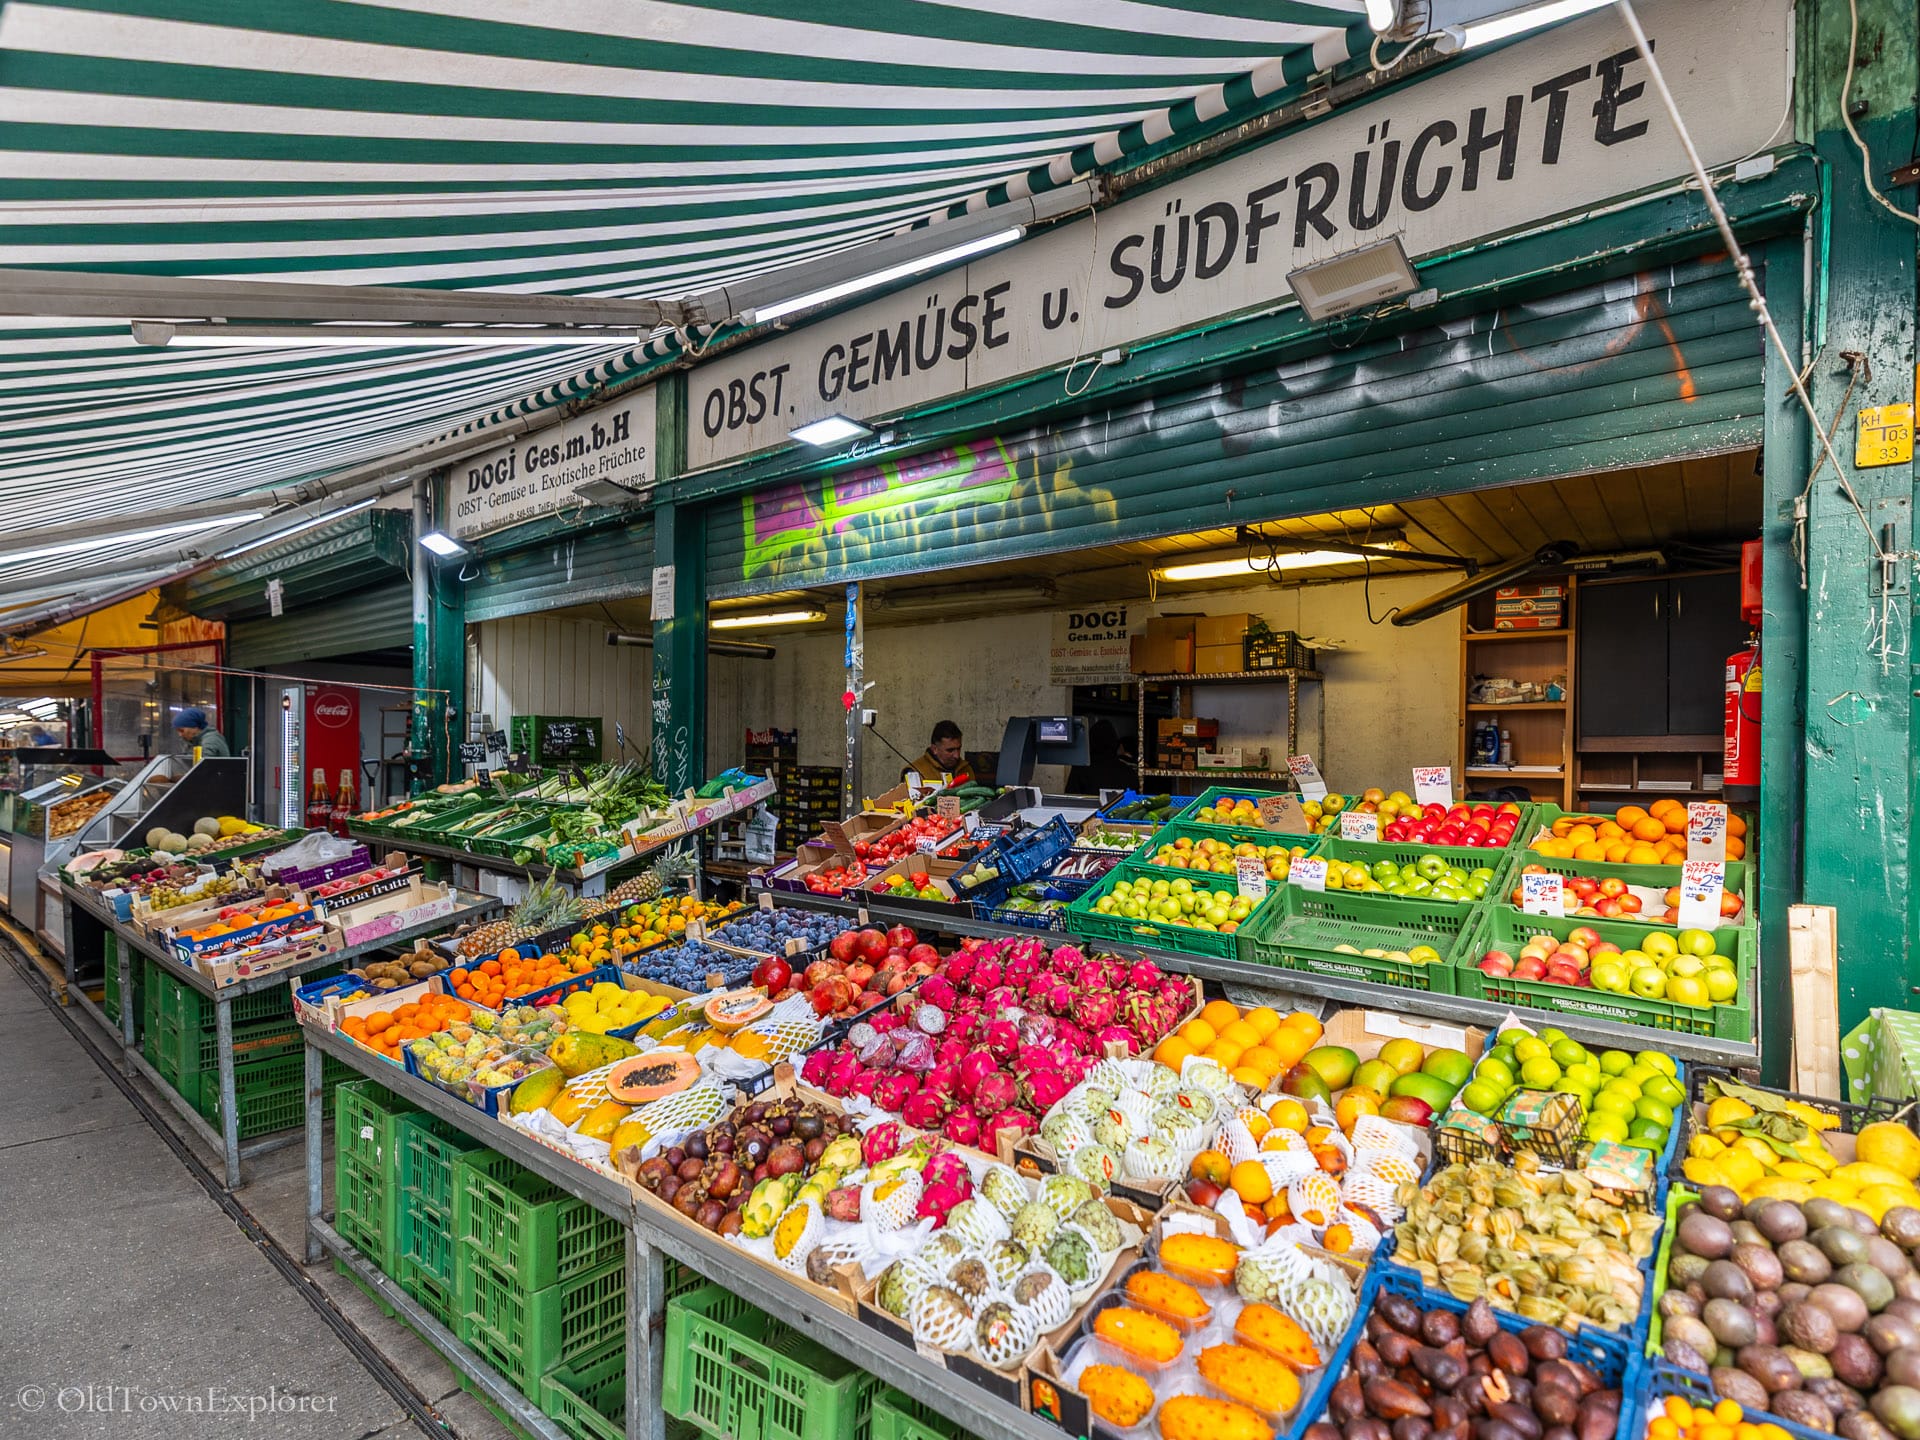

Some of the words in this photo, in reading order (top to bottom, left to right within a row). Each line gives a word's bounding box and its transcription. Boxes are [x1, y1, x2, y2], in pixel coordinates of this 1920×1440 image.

[818, 281, 1011, 401] GEMÜSE
[1042, 288, 1080, 330] u.
[1103, 40, 1655, 309] SÜDFRÜCHTE
[1860, 414, 1880, 428] KH
[525, 410, 631, 473] Ges.m.b.H
[1879, 447, 1898, 460] 33
[529, 484, 538, 494] u.
[541, 463, 595, 490] Exotische
[598, 446, 646, 474] Früchte
[1068, 630, 1127, 642] Ges.m.b.H
[316, 704, 348, 716] Coca-Cola
[1689, 803, 1717, 811] GALA
[1688, 818, 1704, 829] 1kg
[1685, 861, 1721, 869] GOLDEN
[326, 892, 369, 911] Prima
